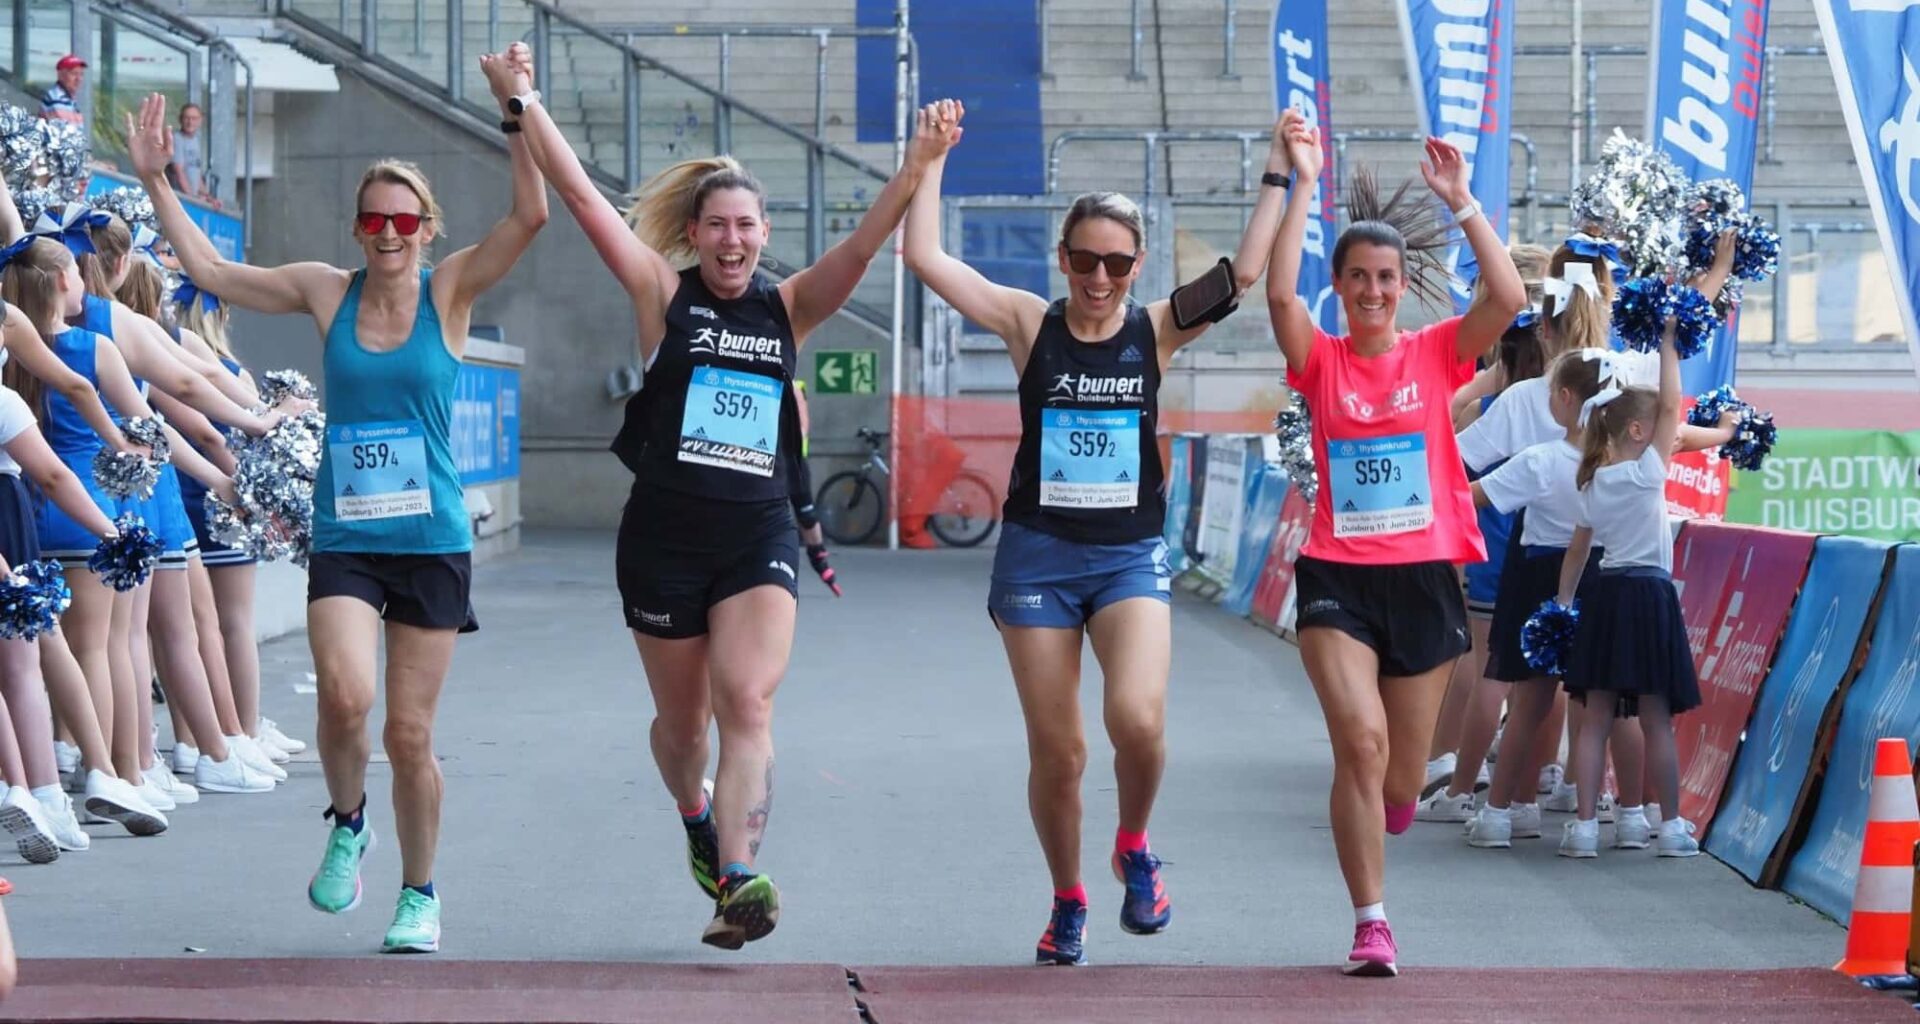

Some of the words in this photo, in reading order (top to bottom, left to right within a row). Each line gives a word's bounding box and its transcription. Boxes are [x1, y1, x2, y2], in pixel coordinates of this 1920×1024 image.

[719, 329, 781, 355] bunert
[718, 348, 754, 361] Duisburg
[1077, 373, 1143, 394] bunert
[1077, 395, 1115, 403] Duisburg
[1763, 456, 1920, 491] STADTW
[1048, 494, 1082, 504] Duisburg
[341, 508, 373, 517] Duisburg
[1341, 523, 1375, 533] Duisburg
